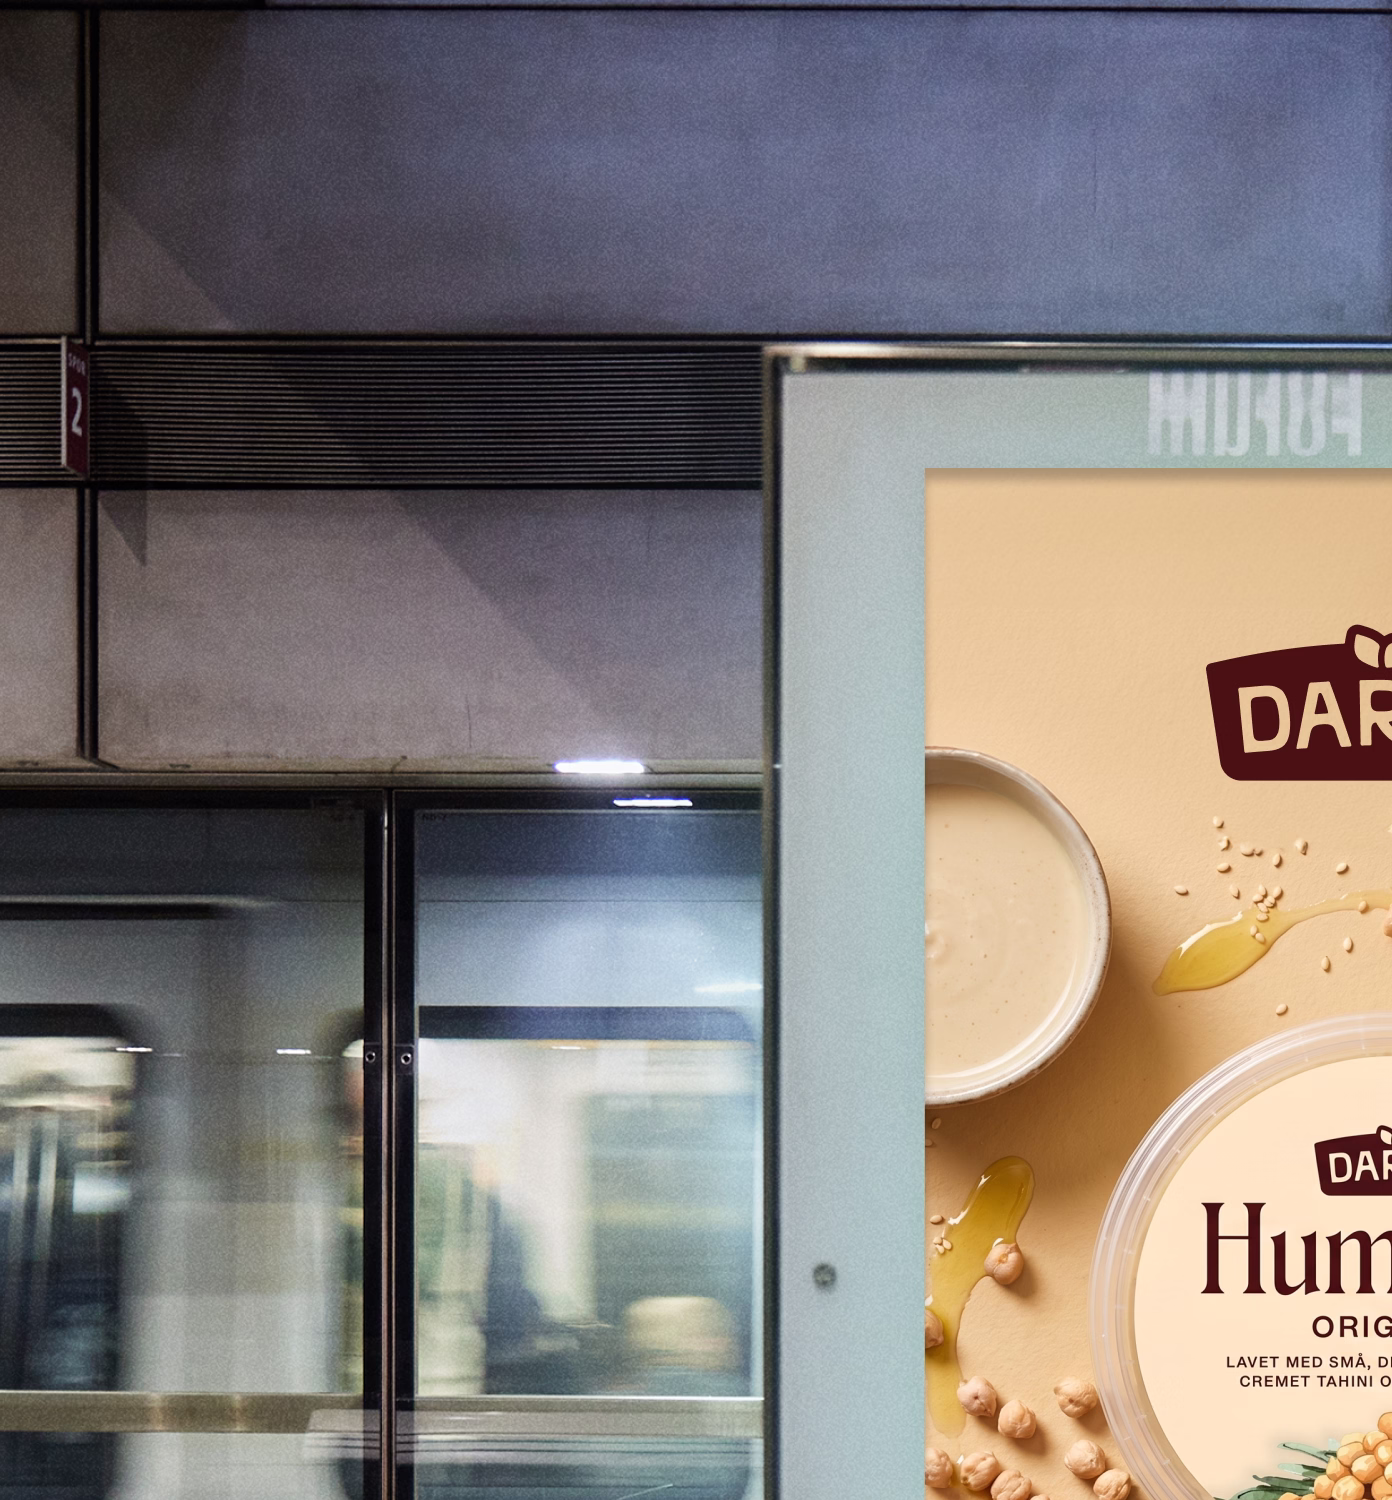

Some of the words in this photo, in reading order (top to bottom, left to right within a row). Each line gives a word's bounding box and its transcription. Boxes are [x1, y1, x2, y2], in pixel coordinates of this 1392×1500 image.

[72, 387, 83, 437] 2
[1226, 1356, 1280, 1369] LAVET
[1286, 1356, 1323, 1369] MED
[1329, 1353, 1372, 1371] SMÅ,
[1239, 1375, 1310, 1388] CREMET
[1316, 1375, 1374, 1388] TAHINI
